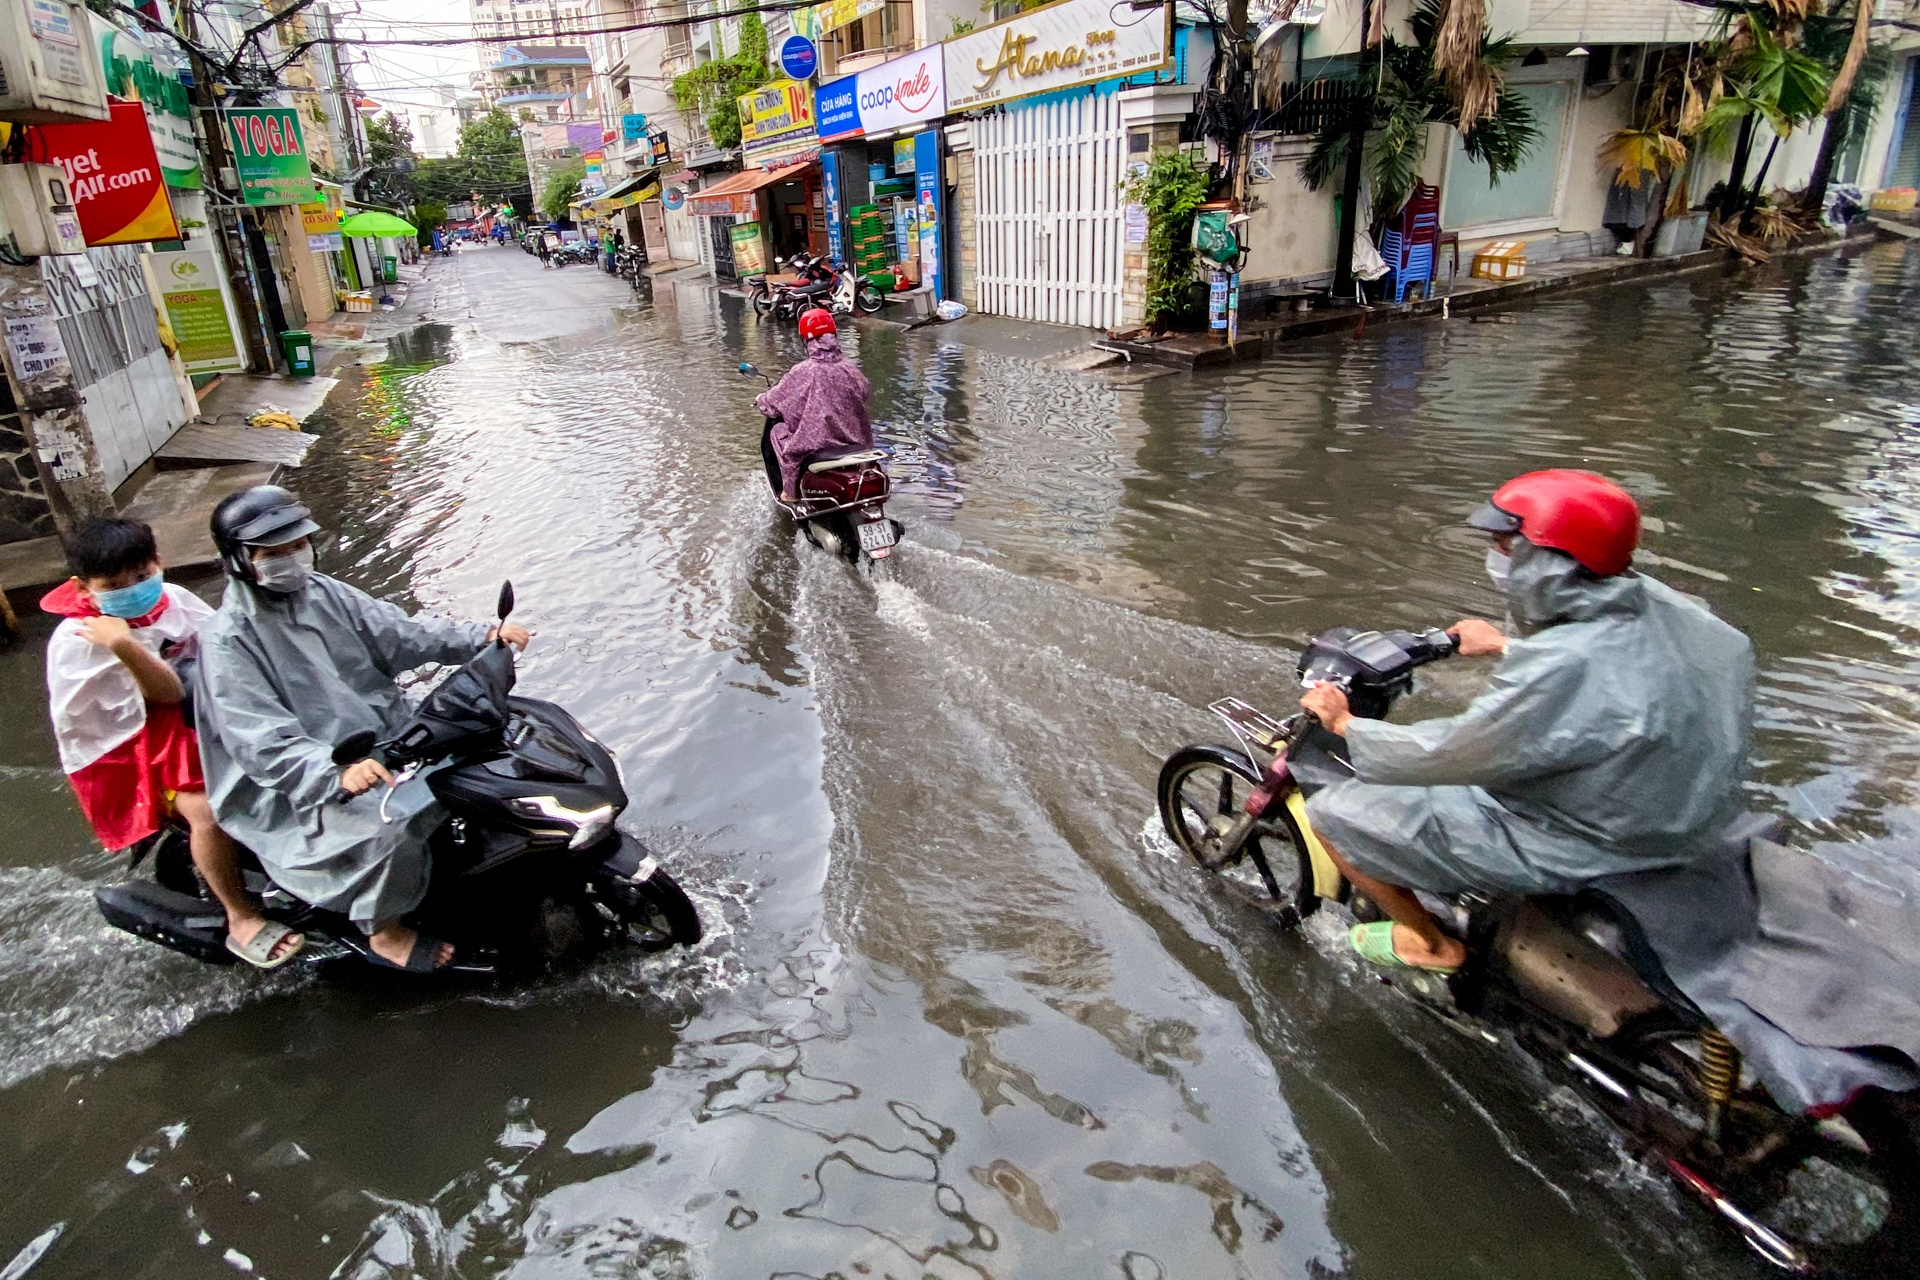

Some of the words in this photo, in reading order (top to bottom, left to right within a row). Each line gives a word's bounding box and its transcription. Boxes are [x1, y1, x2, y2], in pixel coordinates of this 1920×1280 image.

[861, 86, 893, 110] co.op
[894, 62, 930, 101] smile
[821, 97, 834, 113] CỬA
[834, 92, 852, 109] HÀNG
[231, 115, 301, 156] YOGA
[75, 168, 152, 205] Air.com
[167, 294, 197, 305] YOGA
[23, 359, 43, 373] CHO
